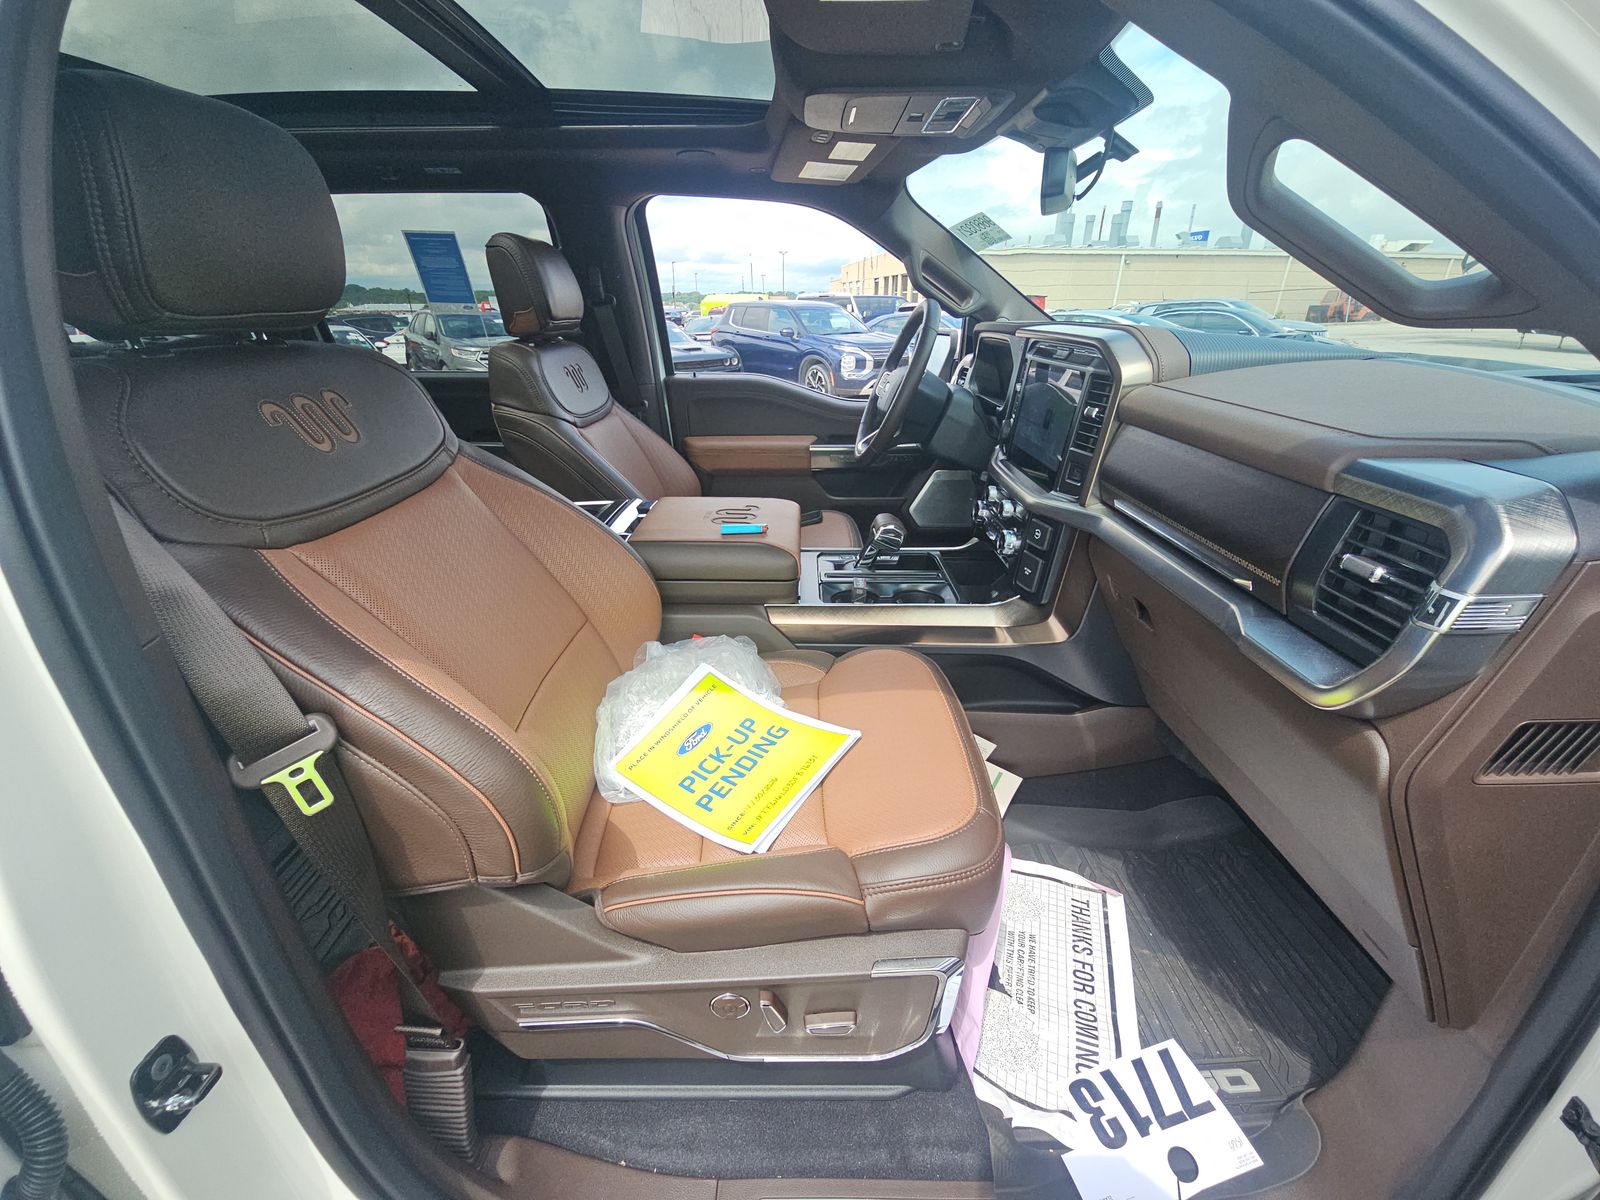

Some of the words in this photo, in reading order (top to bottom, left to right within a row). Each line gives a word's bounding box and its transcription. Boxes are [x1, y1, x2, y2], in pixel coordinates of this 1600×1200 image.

[628, 752, 648, 770] PLACE
[648, 745, 655, 753] IN
[654, 712, 688, 746] WINDSHIELD
[688, 705, 695, 714] OF
[695, 684, 717, 705] VEHICLE
[678, 718, 756, 794] PICK-UP
[695, 725, 789, 812] PENDING
[1006, 931, 1015, 948] WITH
[1017, 931, 1025, 948] YOUR
[1028, 934, 1036, 944] WE
[1071, 897, 1093, 956] THANKS
[1006, 949, 1014, 964] THIS
[1015, 949, 1025, 987] CARPETING
[1028, 945, 1036, 964] HAVE
[1026, 986, 1035, 996] TO
[1072, 958, 1095, 996] FOR
[1026, 996, 1035, 1014] KEEP
[1068, 1047, 1217, 1150] 7713
